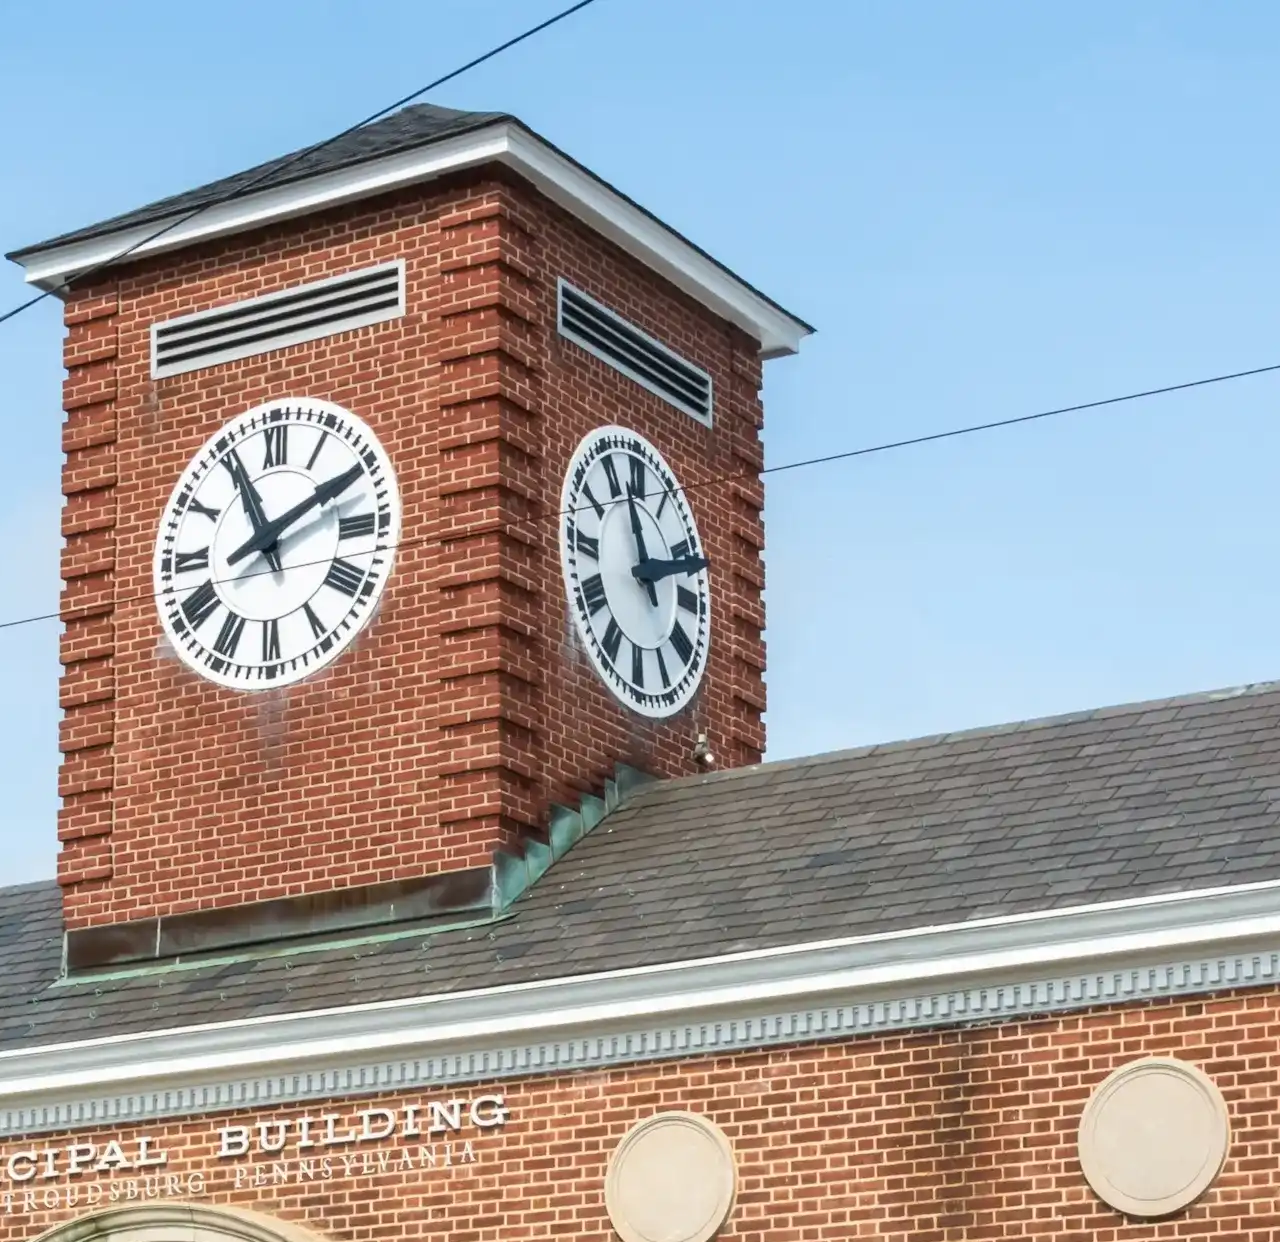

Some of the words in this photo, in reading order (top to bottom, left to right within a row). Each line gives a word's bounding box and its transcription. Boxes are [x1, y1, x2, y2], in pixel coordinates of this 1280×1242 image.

[263, 425, 288, 471] XII
[305, 431, 329, 471] I
[339, 512, 376, 541] III
[175, 546, 210, 574] IX
[212, 611, 247, 659] VII
[262, 619, 281, 662] VI
[215, 1093, 510, 1158] BUILDING
[233, 1140, 479, 1189] PENNSYLVANIA
